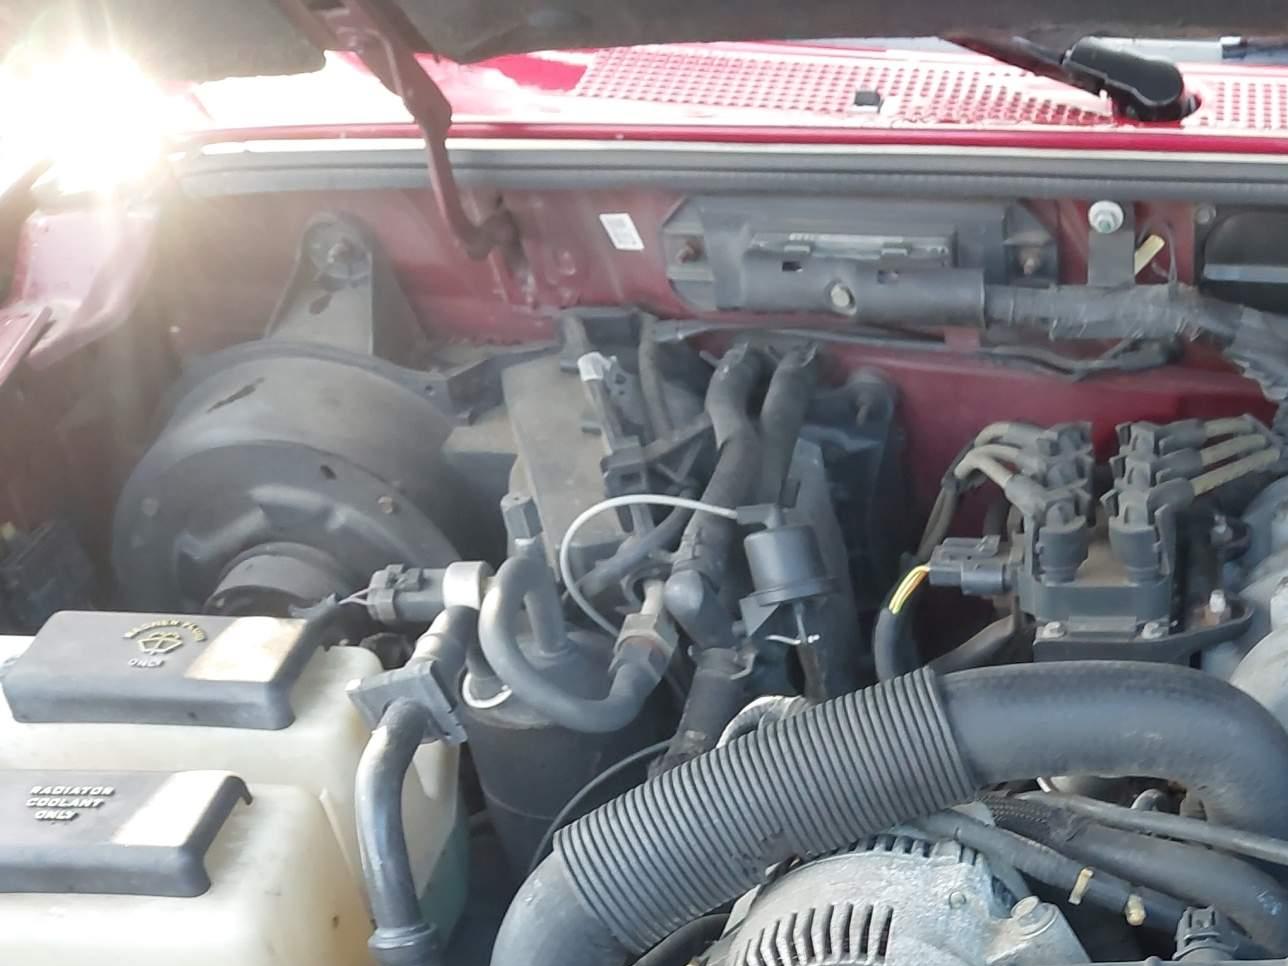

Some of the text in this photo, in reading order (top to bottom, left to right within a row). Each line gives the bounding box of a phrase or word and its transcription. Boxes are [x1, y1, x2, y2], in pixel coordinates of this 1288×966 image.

[30, 786, 115, 796] RADIATOR
[26, 797, 105, 808] COOLANT
[34, 810, 79, 821] ONLY
